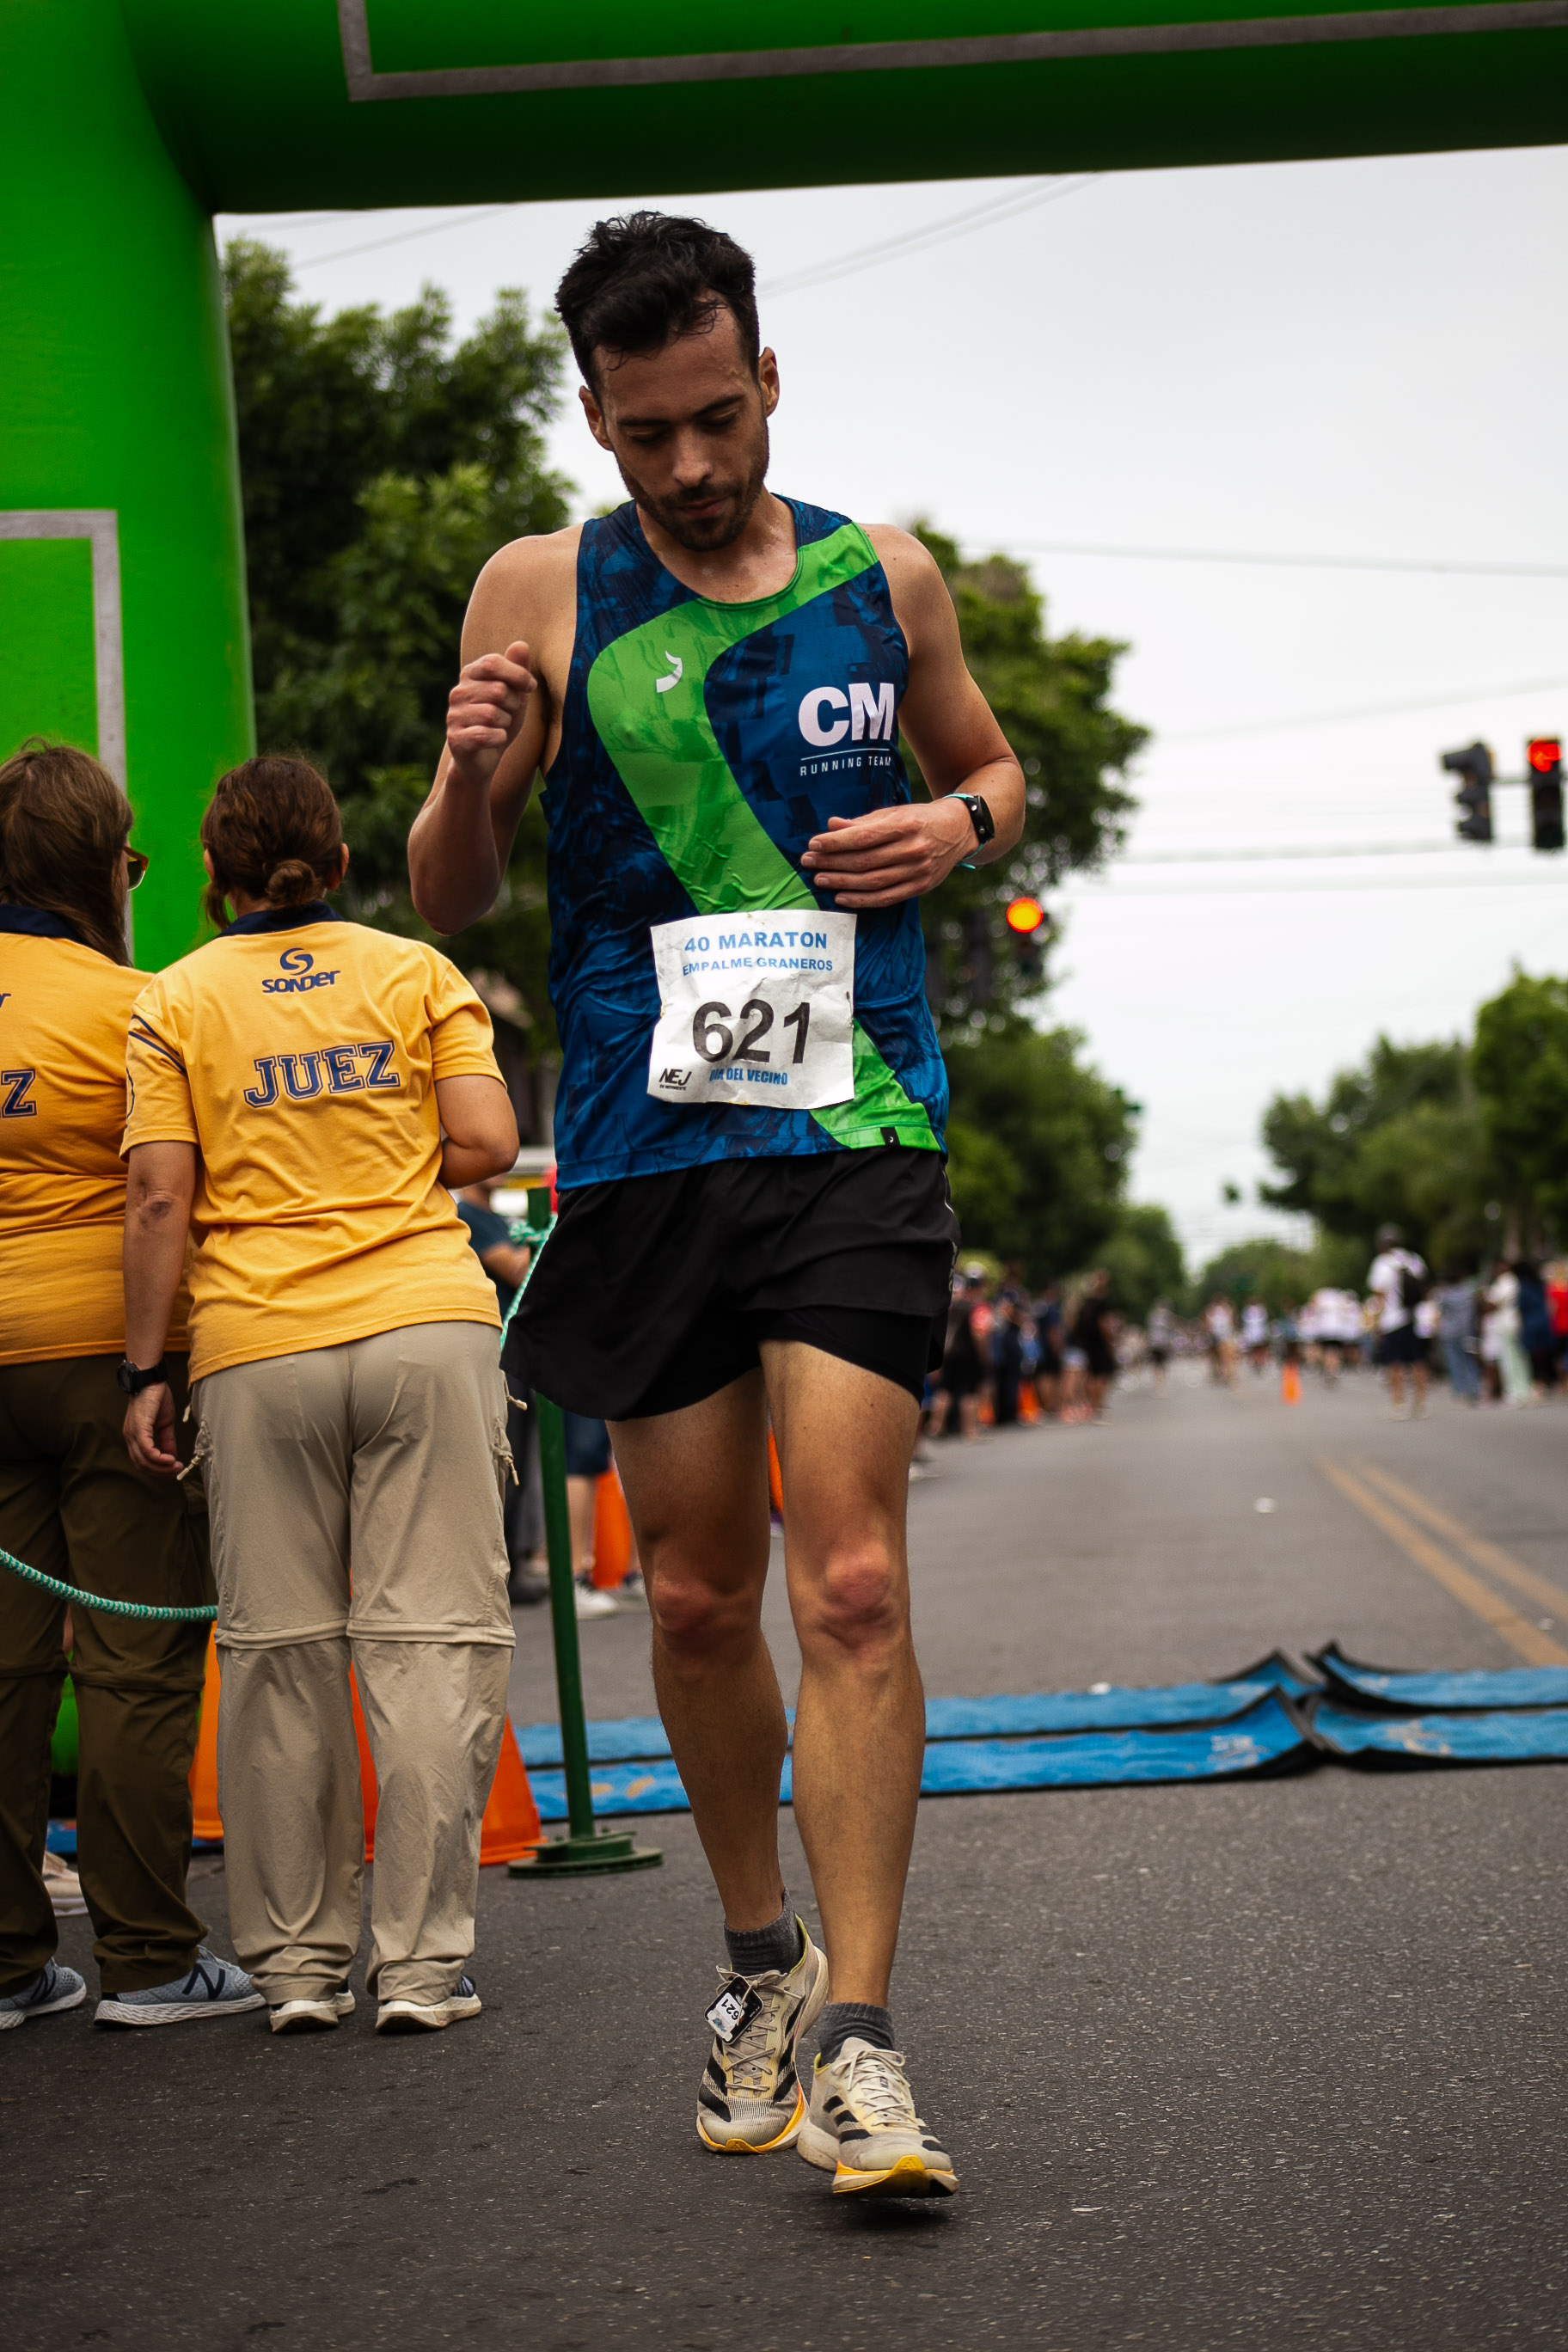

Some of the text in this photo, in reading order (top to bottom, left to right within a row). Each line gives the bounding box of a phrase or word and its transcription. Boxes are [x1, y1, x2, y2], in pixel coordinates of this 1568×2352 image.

[799, 683, 895, 747] CM
[799, 756, 891, 777] RUNNING TEAM
[684, 931, 828, 952] 40 MARATON
[683, 957, 833, 977] EMPALME GRANEROS
[693, 998, 811, 1064] 621
[243, 1039, 401, 1109] JUEZ
[709, 1068, 788, 1086] DIA DEL VECINO
[721, 1998, 739, 2020] 621
